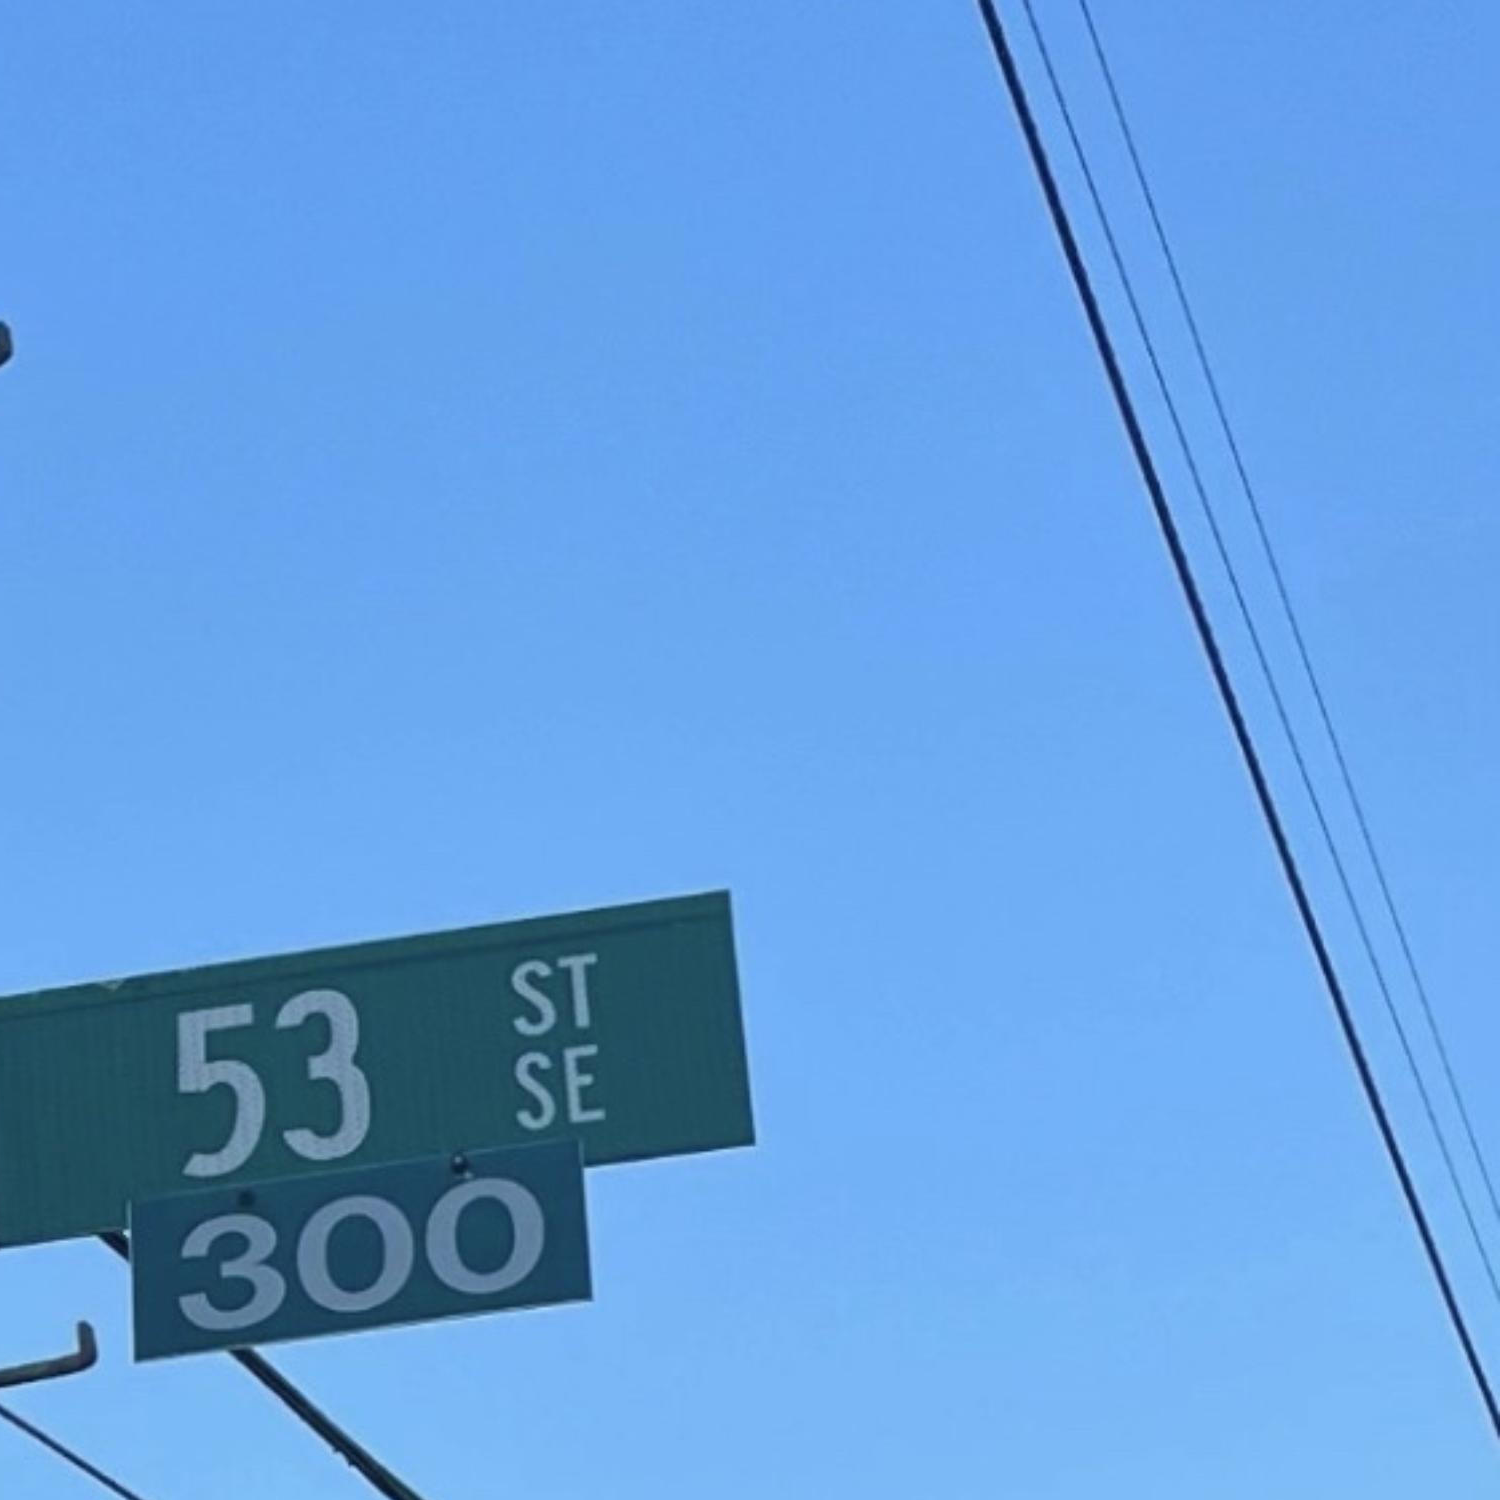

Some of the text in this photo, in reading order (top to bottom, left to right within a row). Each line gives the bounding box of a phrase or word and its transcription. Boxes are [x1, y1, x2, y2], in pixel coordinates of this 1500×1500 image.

[176, 953, 598, 1178] 53 ST
[515, 1045, 606, 1130] SE
[178, 1178, 546, 1332] 300
